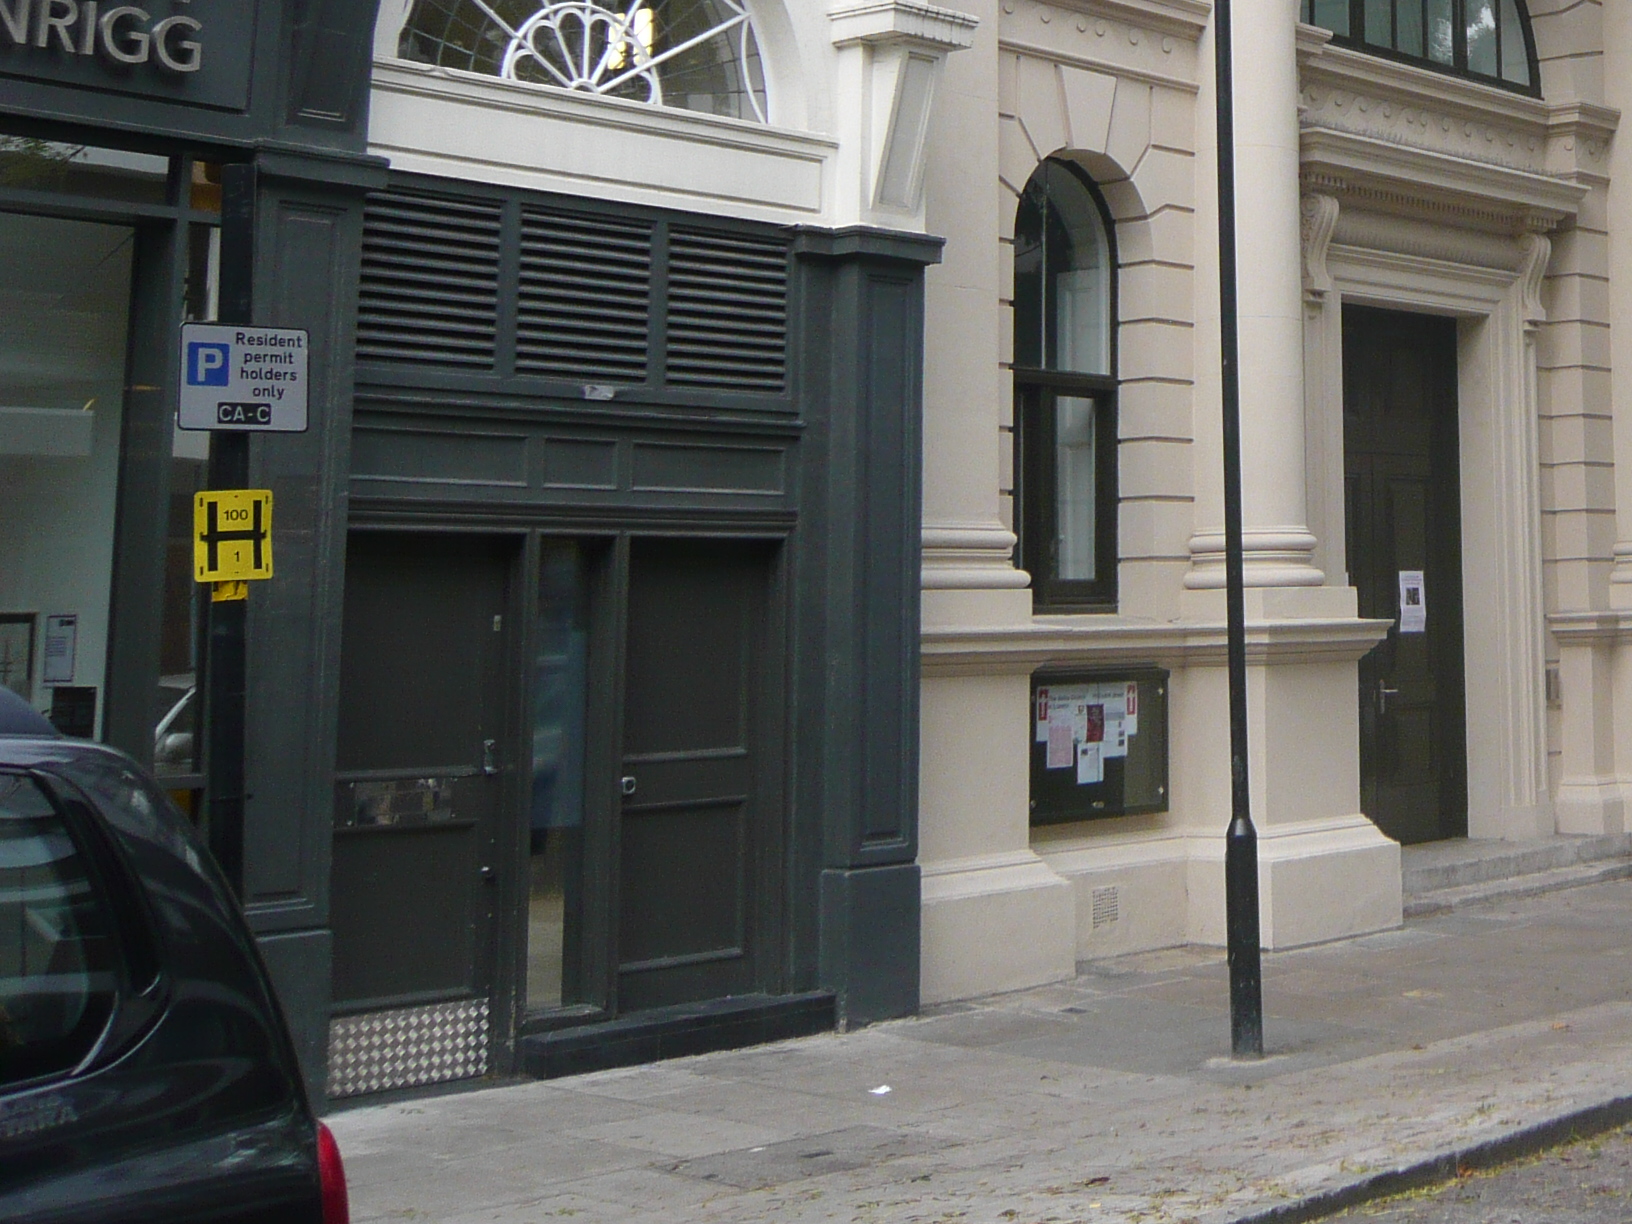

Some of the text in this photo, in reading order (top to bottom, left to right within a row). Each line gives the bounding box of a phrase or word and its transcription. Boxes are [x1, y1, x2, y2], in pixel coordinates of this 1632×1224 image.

[235, 331, 303, 349] Resident
[197, 347, 223, 382] P
[243, 351, 294, 366] permit
[239, 367, 298, 382] holders
[252, 385, 285, 401] only
[223, 509, 249, 522] 100
[233, 550, 240, 562] 1
